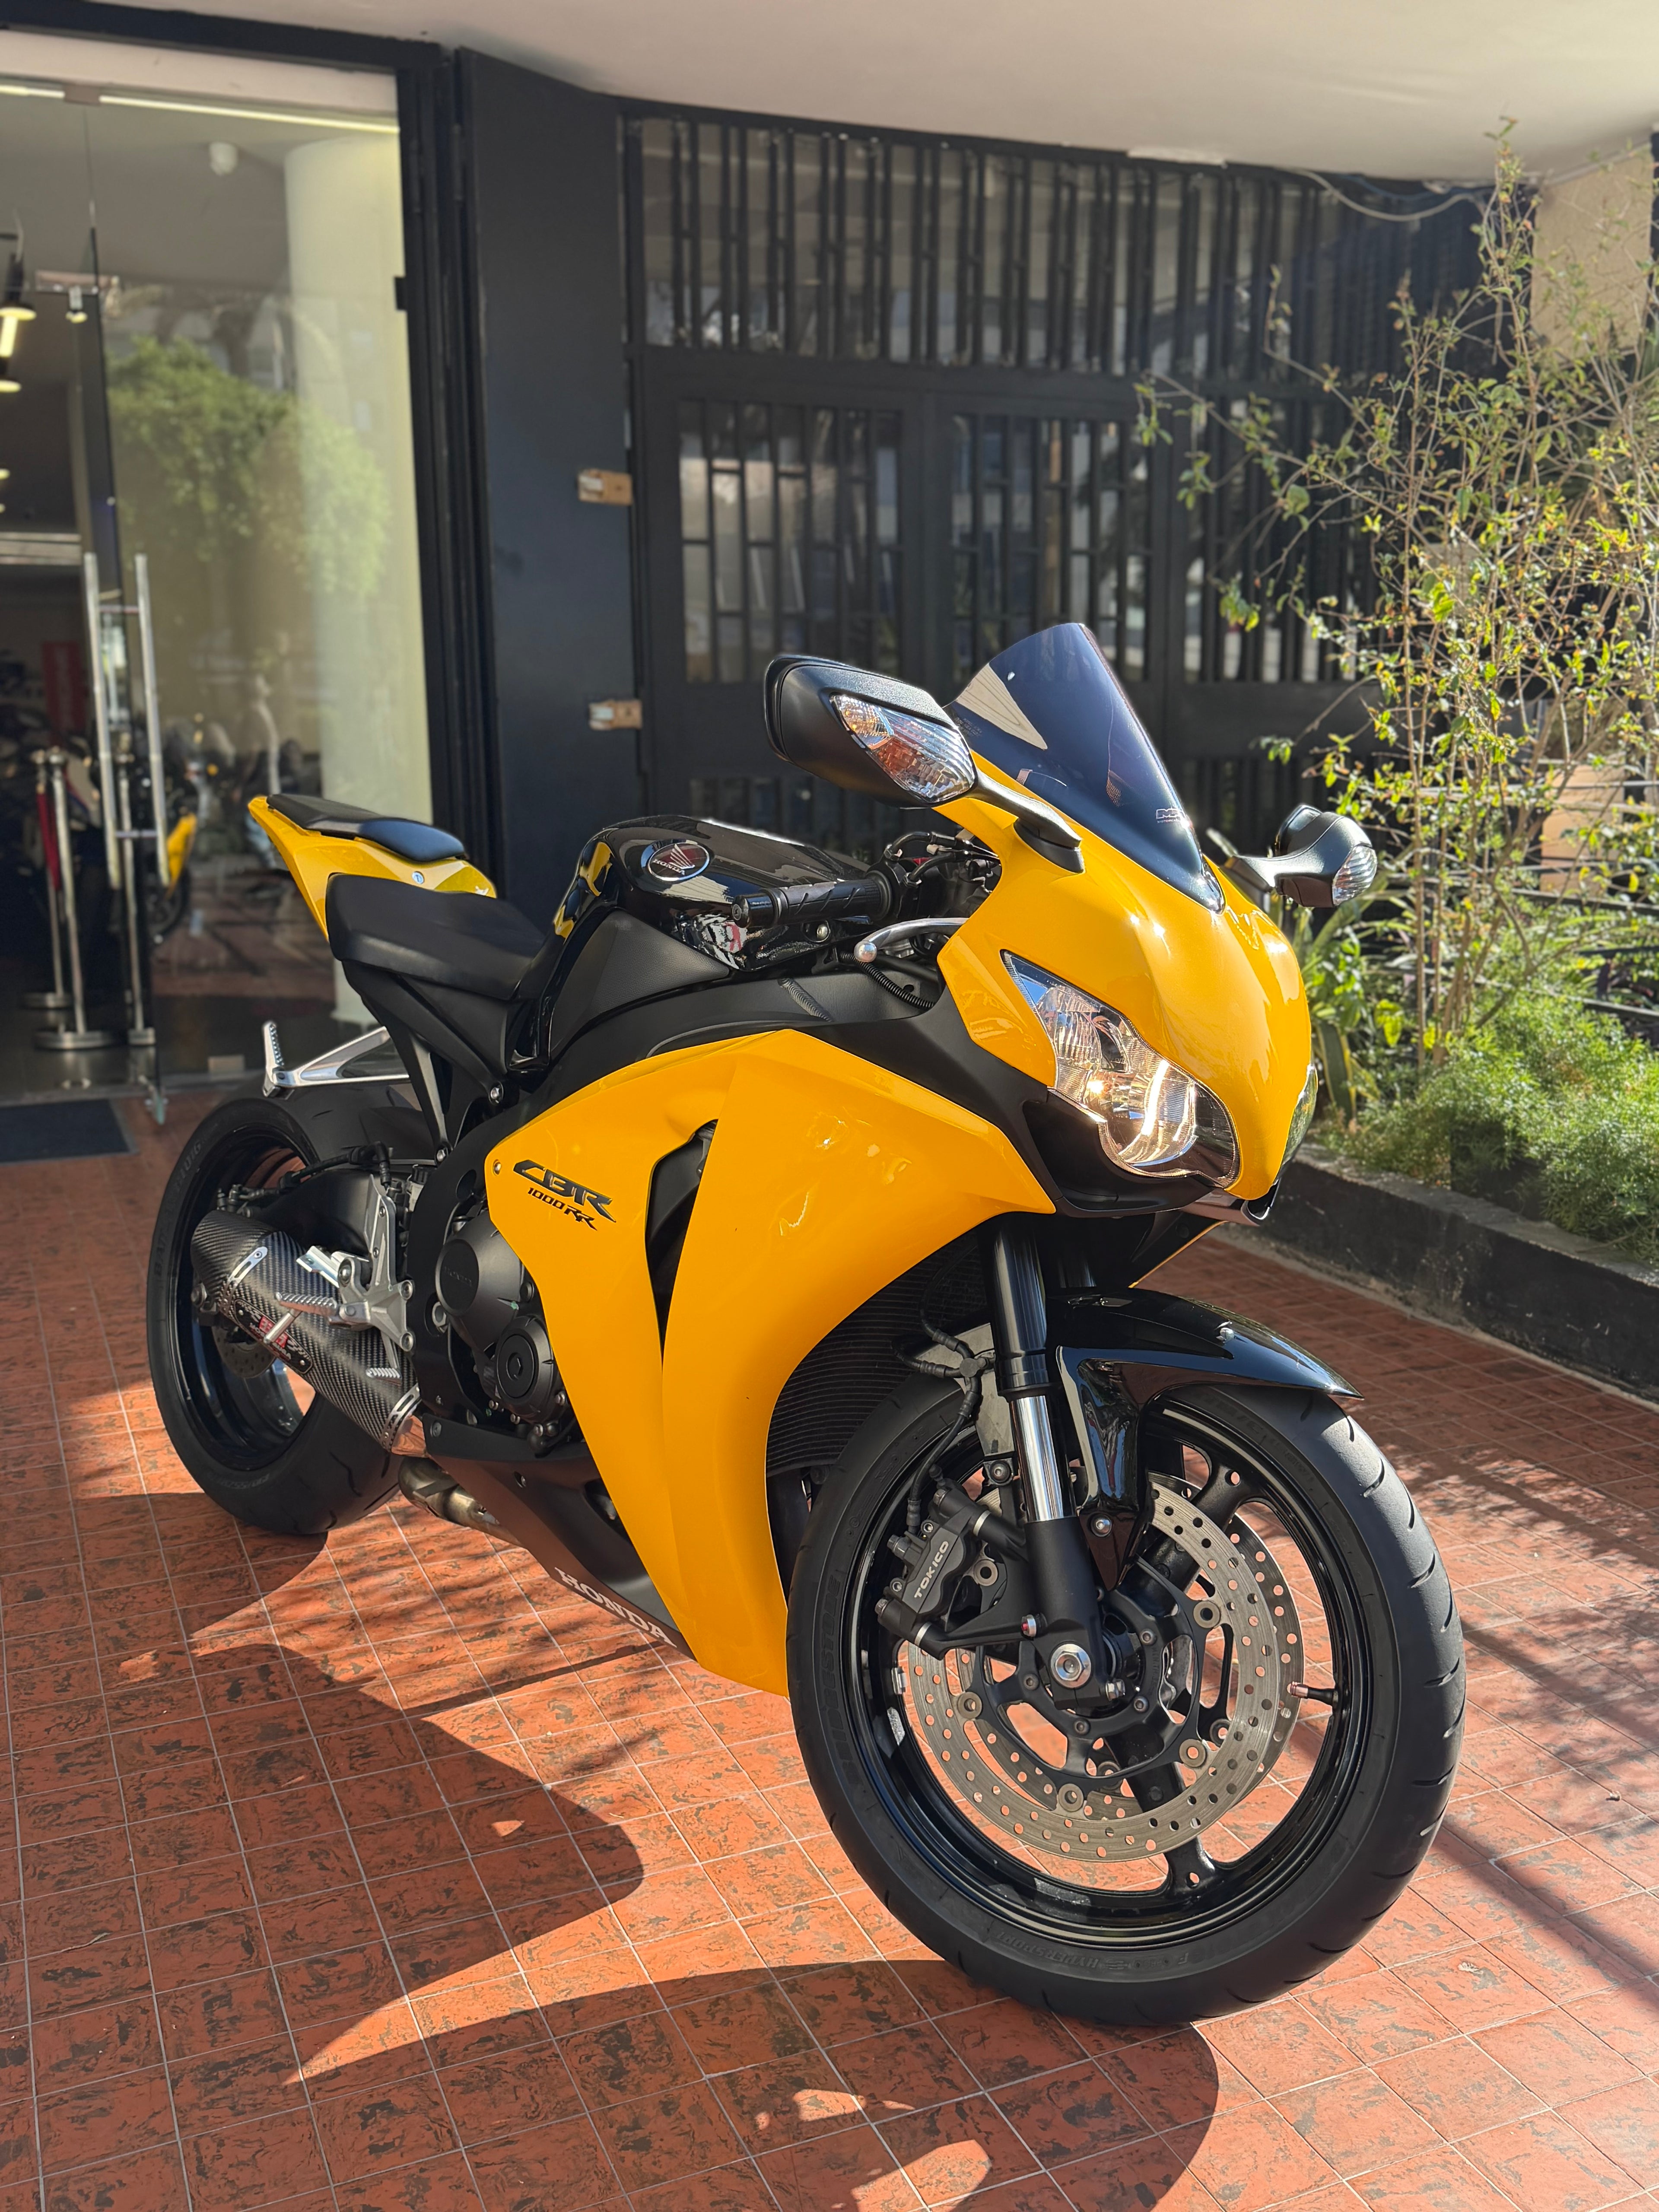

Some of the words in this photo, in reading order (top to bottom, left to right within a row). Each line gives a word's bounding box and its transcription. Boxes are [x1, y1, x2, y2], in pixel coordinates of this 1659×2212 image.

[652, 859, 685, 875] HONDA
[513, 1159, 617, 1223] CBR
[914, 1541, 949, 1599] TOKICO
[554, 1567, 677, 1648] HONDA
[997, 1932, 1099, 1968] HYPERSPORT
